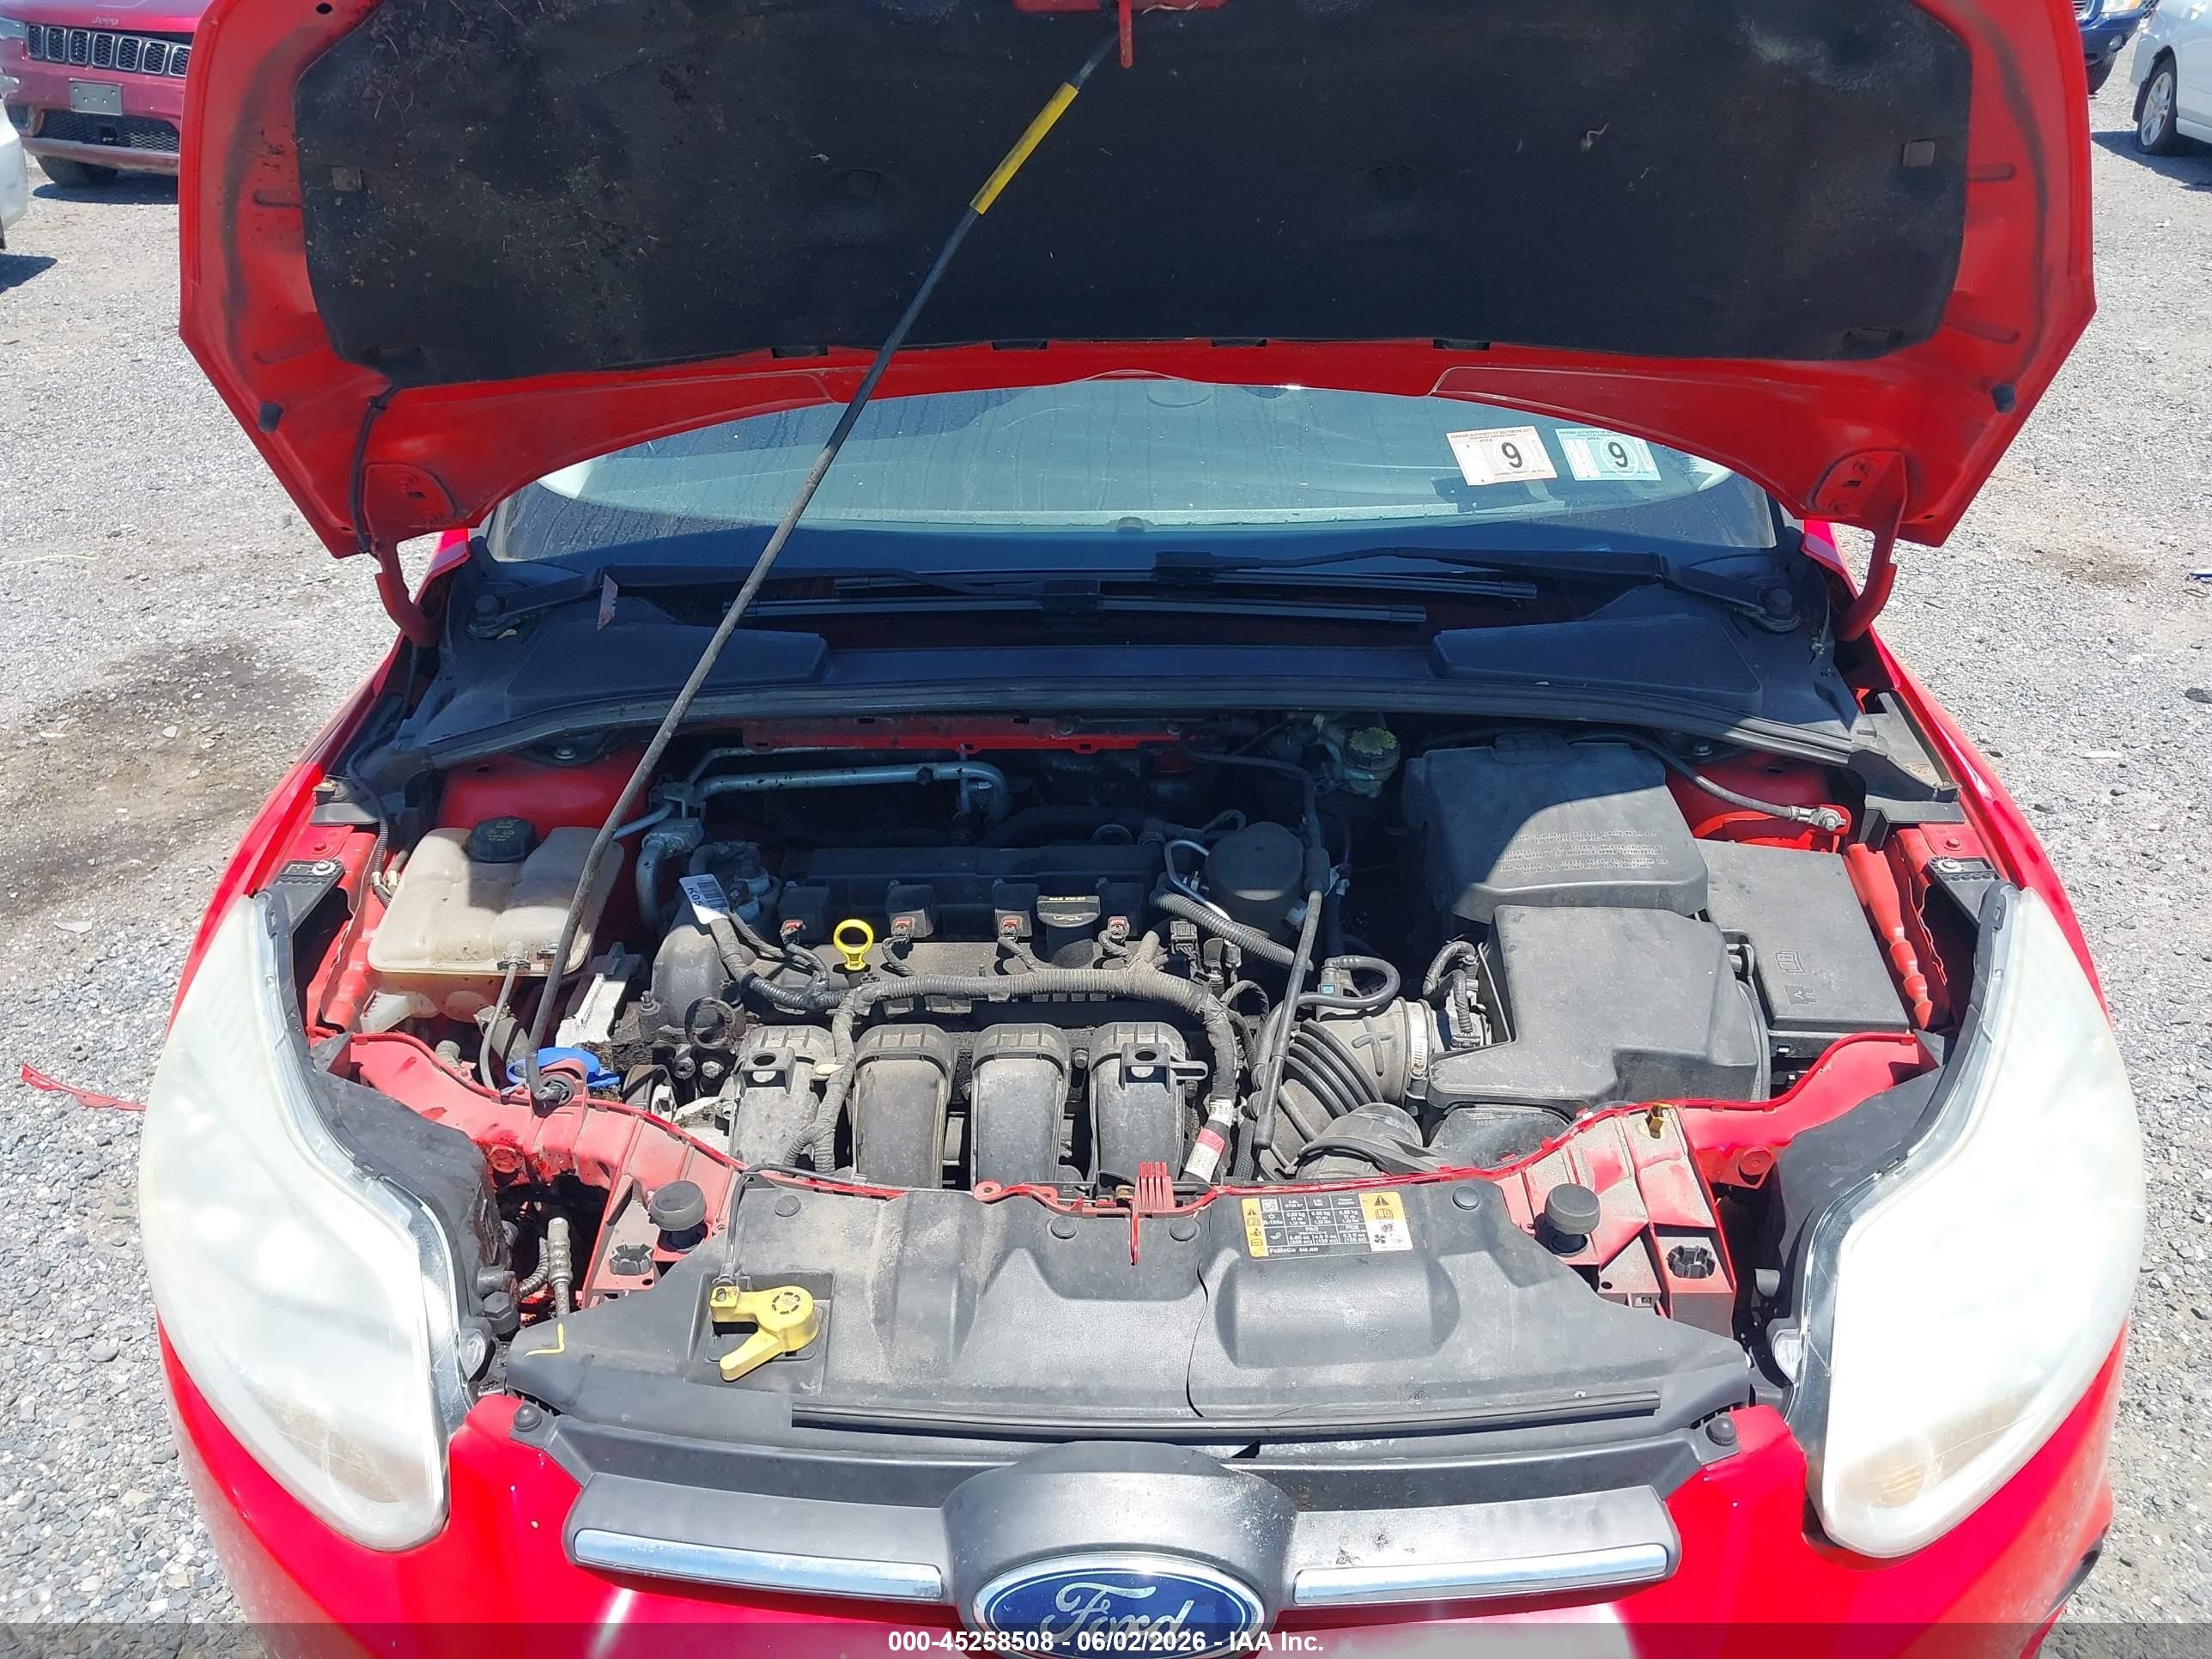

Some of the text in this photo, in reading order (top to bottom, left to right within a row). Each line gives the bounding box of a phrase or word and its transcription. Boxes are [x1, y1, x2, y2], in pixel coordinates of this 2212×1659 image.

[1501, 441, 1523, 468] 9
[1607, 441, 1629, 468] 9
[1040, 1582, 1194, 1644] Ford
